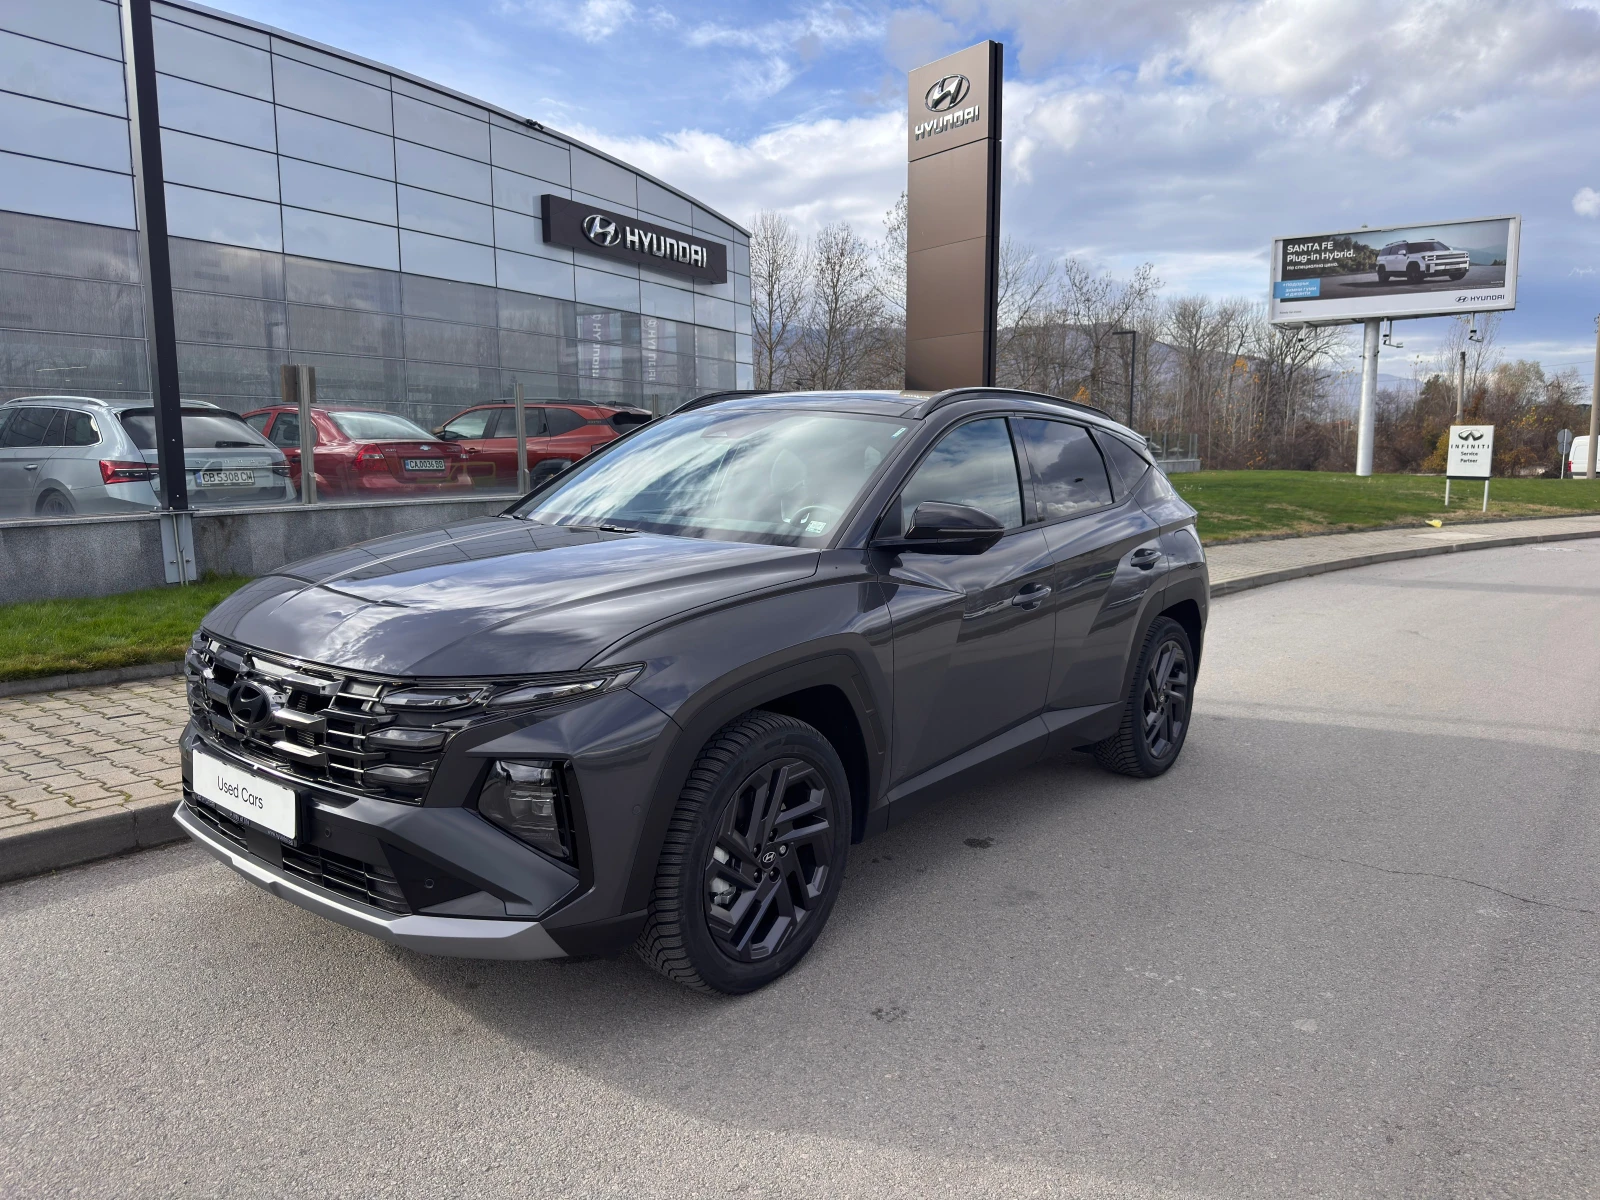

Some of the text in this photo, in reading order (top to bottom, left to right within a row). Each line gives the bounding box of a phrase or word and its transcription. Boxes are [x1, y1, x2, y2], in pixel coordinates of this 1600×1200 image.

[915, 105, 979, 141] HYUNDAI
[626, 226, 707, 268] HYUNDAI
[1287, 241, 1334, 253] SANTA FE
[1287, 249, 1356, 263] Plug-in Hybrid.
[202, 472, 253, 482] CB 5308 CM
[217, 775, 239, 798] Used
[241, 787, 264, 810] Cars
